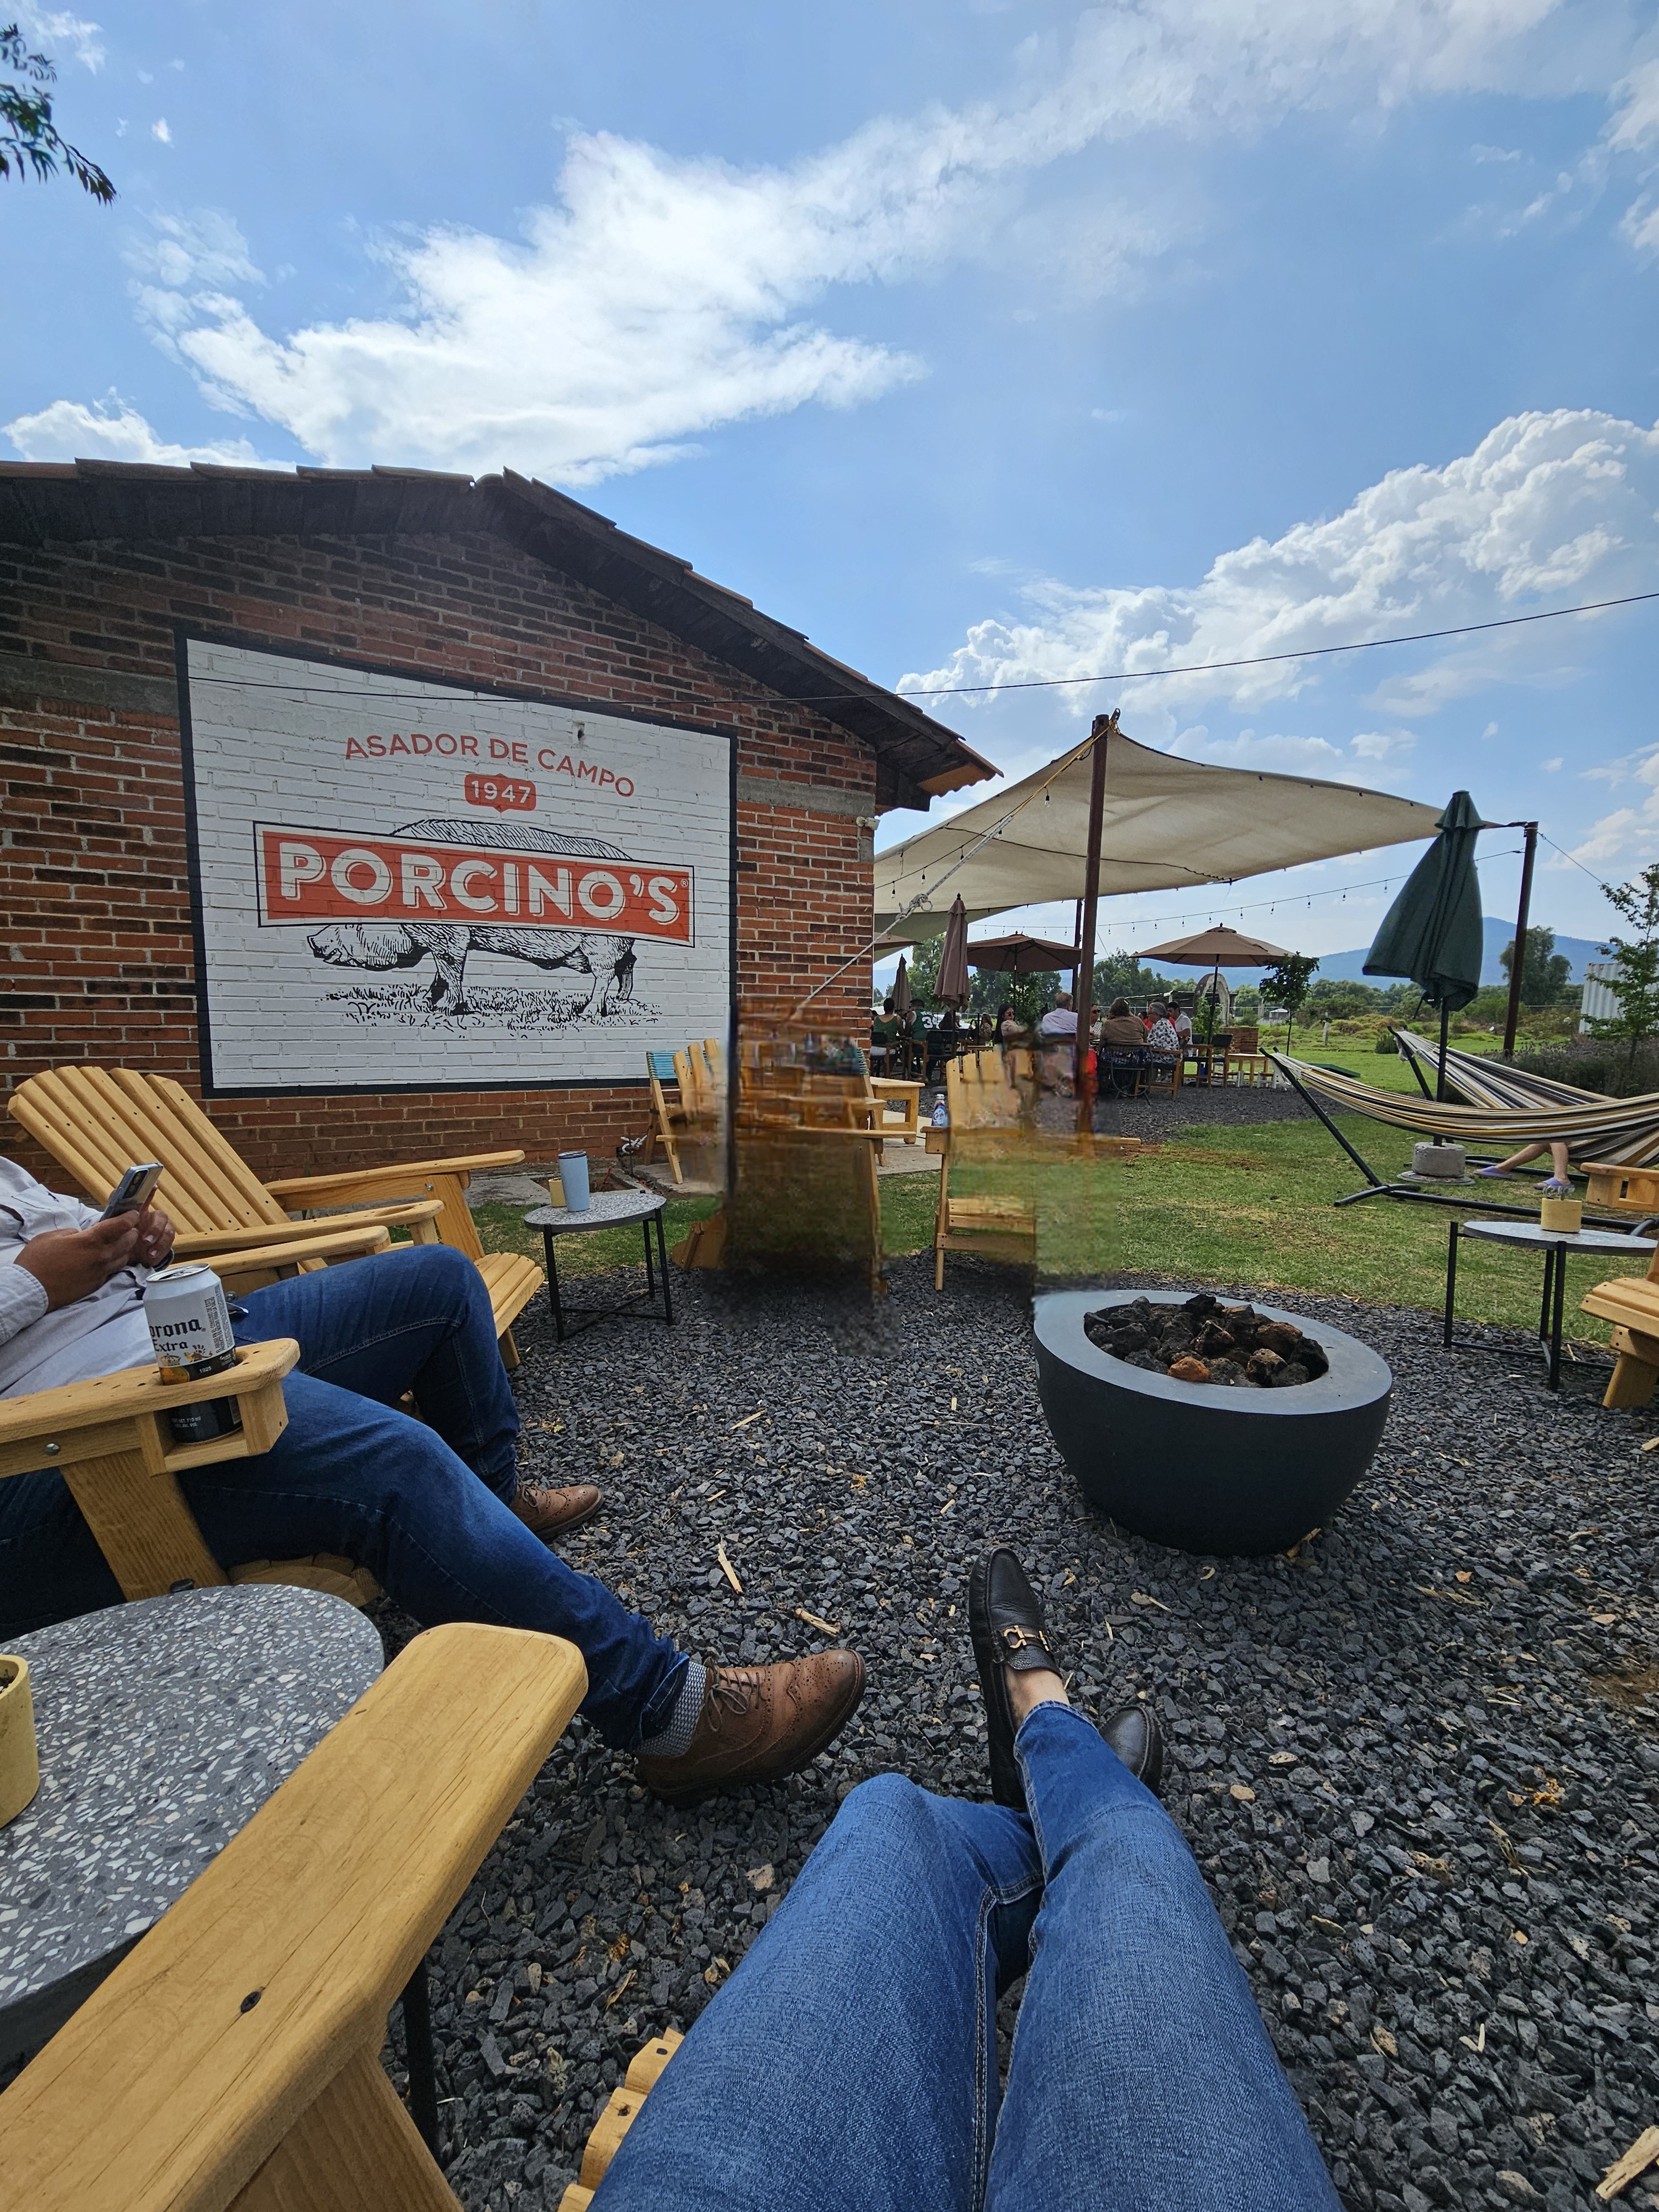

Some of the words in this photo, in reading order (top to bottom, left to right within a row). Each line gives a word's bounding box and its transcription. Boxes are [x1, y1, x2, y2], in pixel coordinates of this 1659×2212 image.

[345, 733, 479, 760] ASADOR
[490, 738, 529, 765] DE
[537, 749, 635, 797] CAMPO
[471, 779, 531, 805] 1947
[279, 841, 680, 926] PORCINO'S
[149, 1319, 202, 1338] orona
[152, 1339, 189, 1352] Extra
